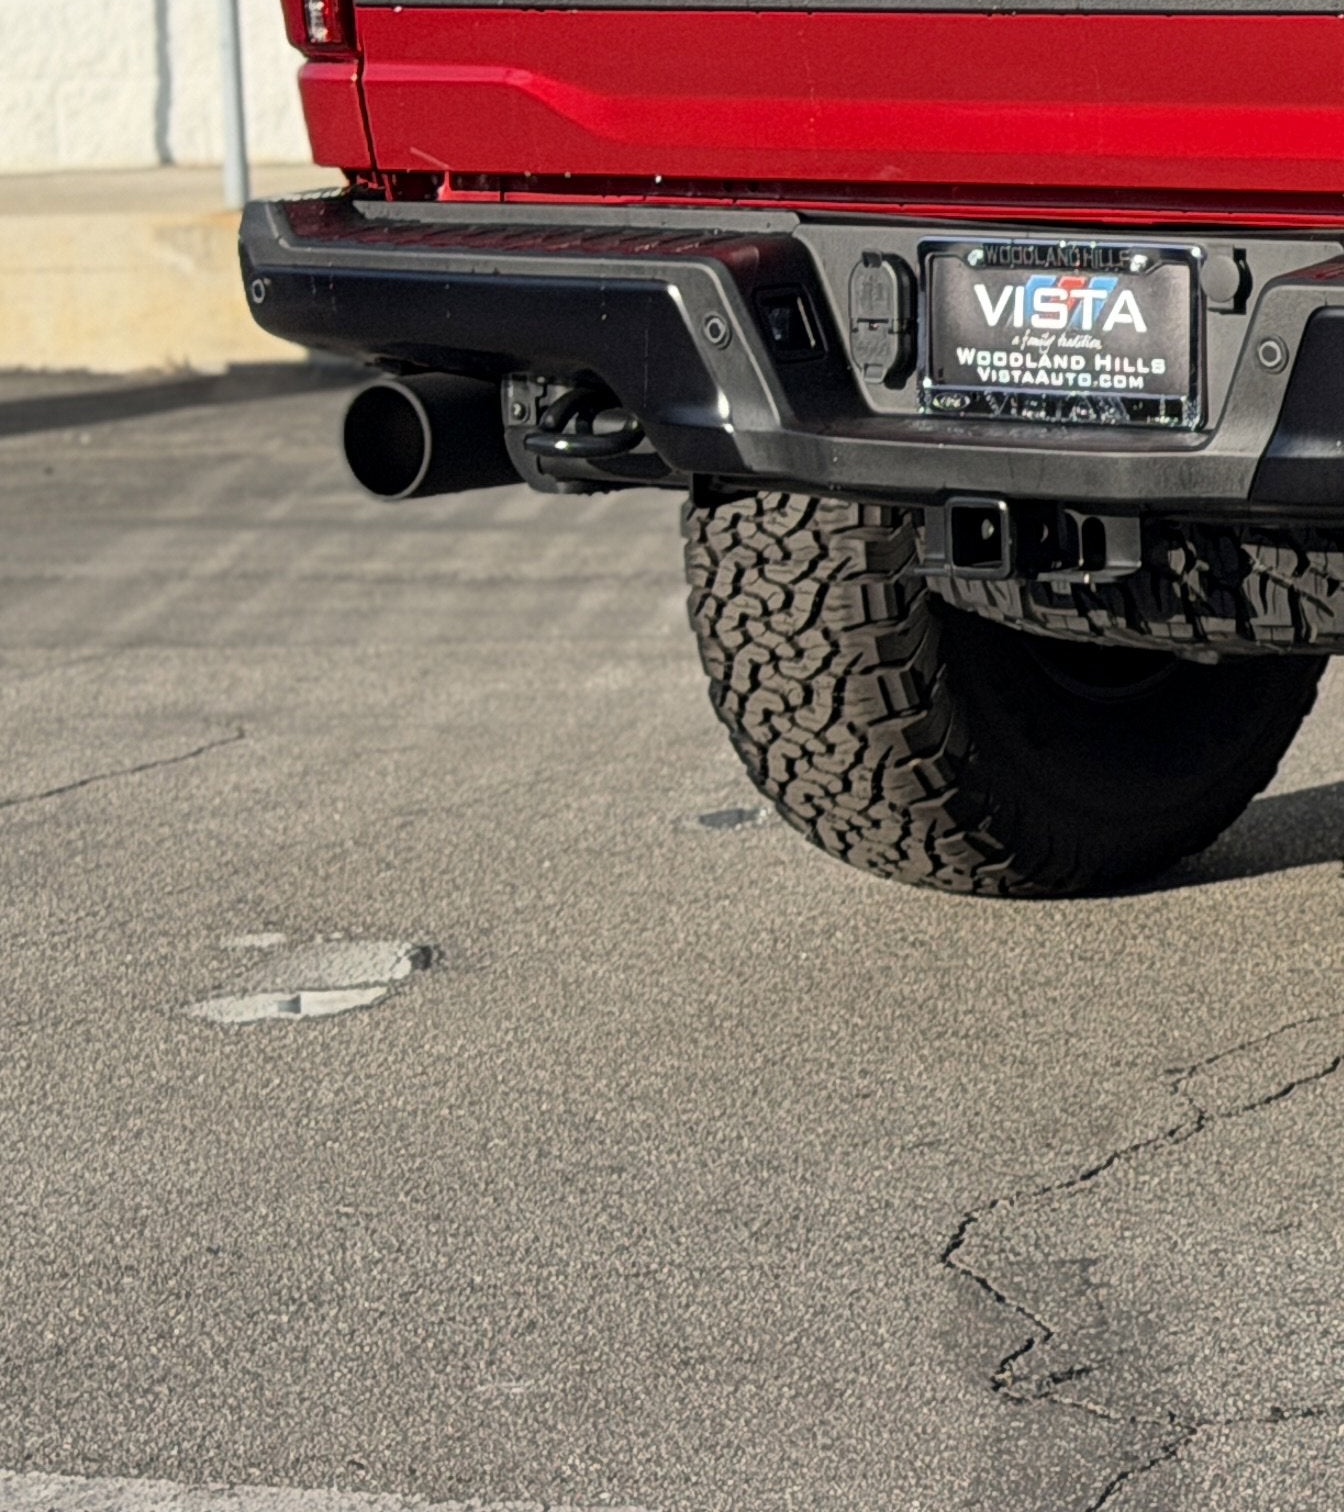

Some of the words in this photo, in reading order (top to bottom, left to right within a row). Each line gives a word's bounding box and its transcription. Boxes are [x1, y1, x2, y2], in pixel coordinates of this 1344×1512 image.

[985, 245, 1080, 267] WOODLAND
[974, 284, 1147, 333] VISTA
[956, 347, 1086, 370] WOODLAND
[1094, 354, 1166, 374] HILLS
